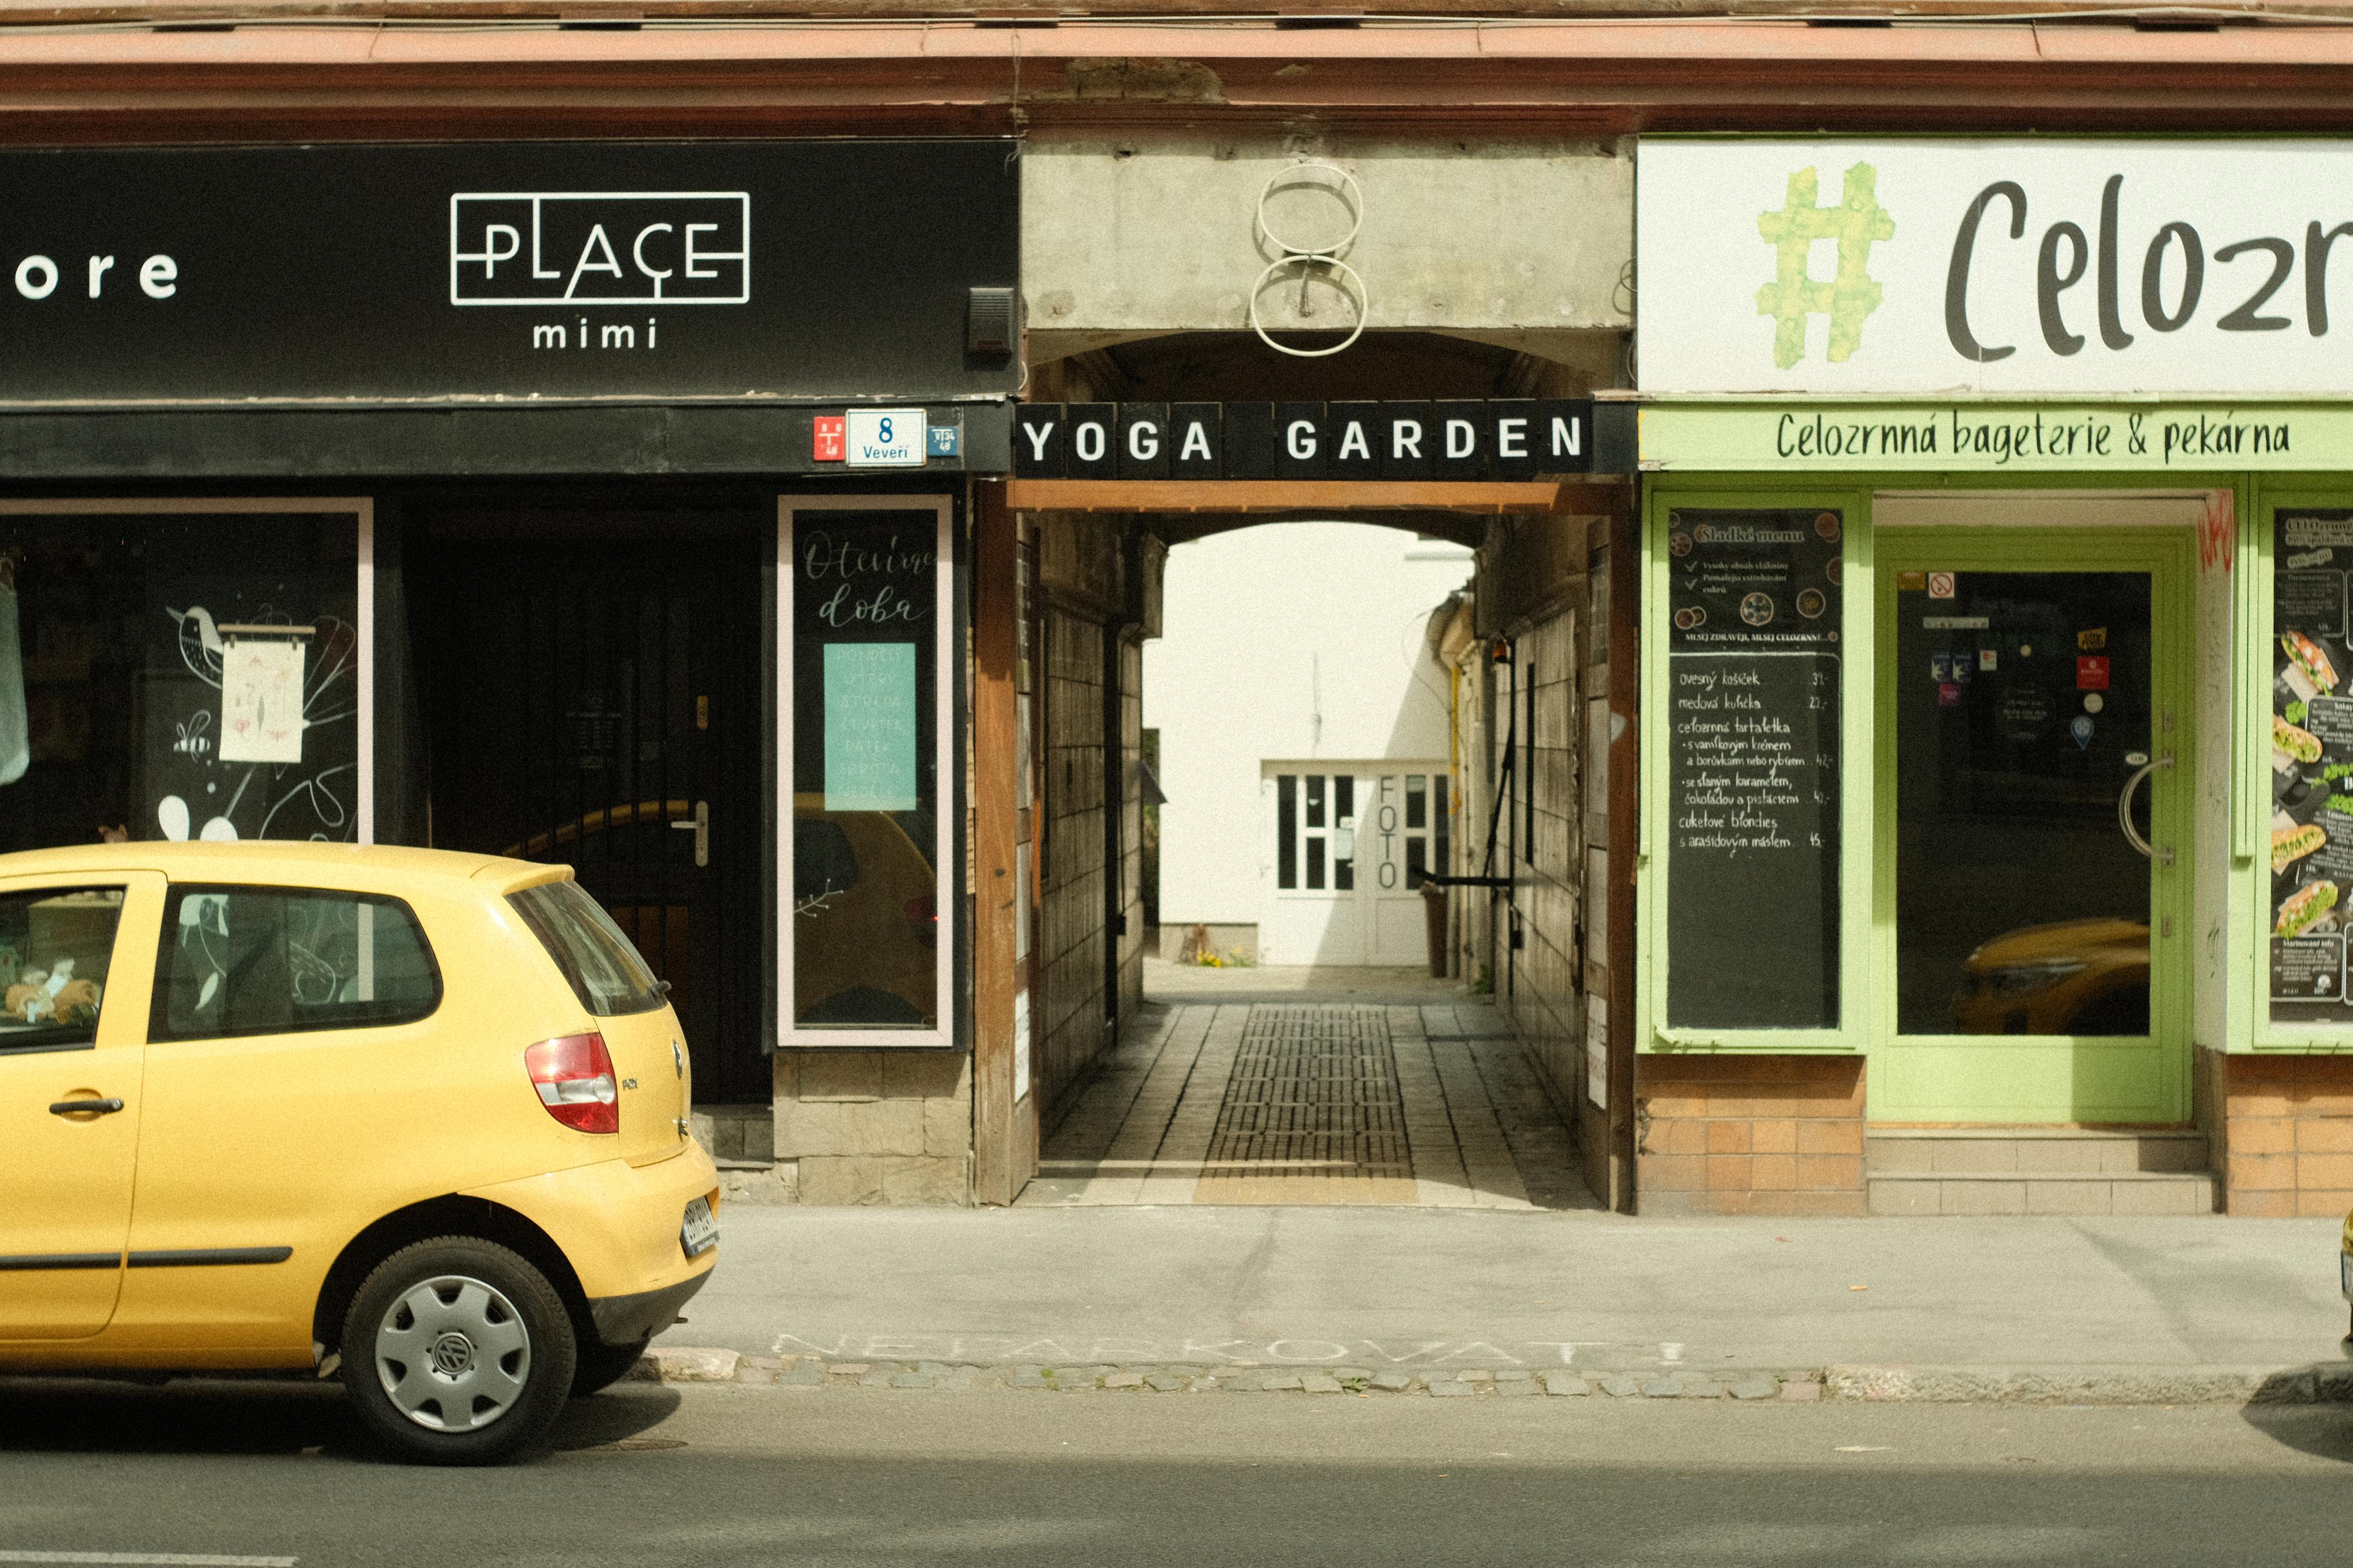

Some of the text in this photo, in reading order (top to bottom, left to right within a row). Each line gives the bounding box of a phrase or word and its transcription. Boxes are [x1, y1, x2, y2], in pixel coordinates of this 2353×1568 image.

[482, 200, 724, 298] PLACE
[534, 318, 655, 348] mimi
[879, 417, 893, 443] 8
[1024, 418, 1579, 461] YOGA GARDEN
[1778, 411, 2289, 464] Celozrnná bageterie & pekárna
[864, 443, 908, 459] Veveří
[1701, 526, 1805, 542] Sladké menu
[819, 583, 927, 628] doba
[1679, 670, 1717, 690] ovesný
[1722, 669, 1760, 685] košíček
[1679, 693, 1718, 709] medová
[1725, 692, 1761, 709] kulička
[1678, 716, 1790, 733] celozrnná tartaletka
[1694, 735, 1748, 756] vanilkovým
[1751, 736, 1791, 751] krémem
[1687, 758, 1693, 766] a
[1697, 752, 1744, 766] borůvkami
[1747, 753, 1767, 765] nebo
[1769, 752, 1805, 777] rybízem
[1686, 778, 1695, 788] se
[1697, 771, 1731, 793] slaným
[1685, 790, 1734, 805] čokoládou
[1747, 789, 1799, 813] pistáciemi
[1679, 809, 1778, 828] cuketové blondies
[1379, 775, 1396, 889] FOTO
[1679, 837, 1685, 847] s
[1689, 830, 1748, 858] arašídovým
[1752, 828, 1791, 848] máslem
